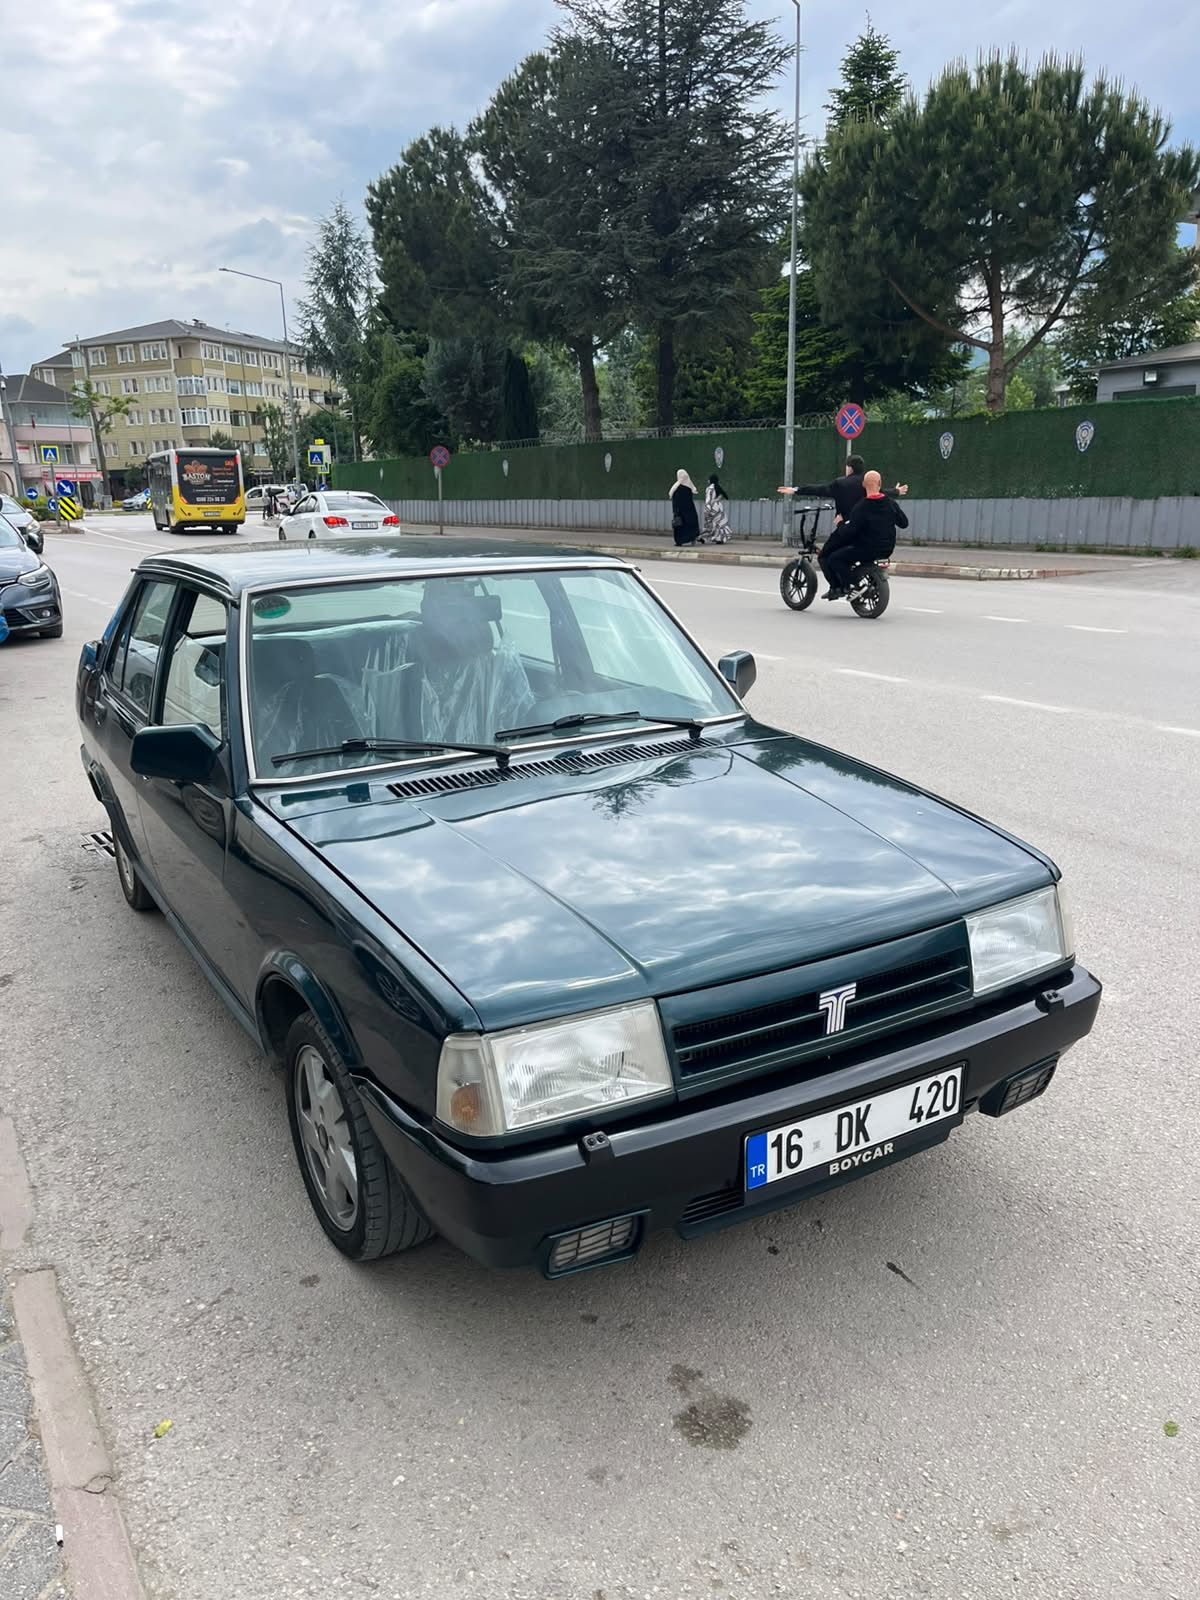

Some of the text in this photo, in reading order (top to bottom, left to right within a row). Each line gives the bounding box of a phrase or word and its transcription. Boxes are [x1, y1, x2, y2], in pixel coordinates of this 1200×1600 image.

[182, 473, 211, 481] BASTON
[771, 1075, 958, 1174] 16 DK 420
[750, 1163, 766, 1179] TR
[829, 1143, 894, 1176] BOYCAR
